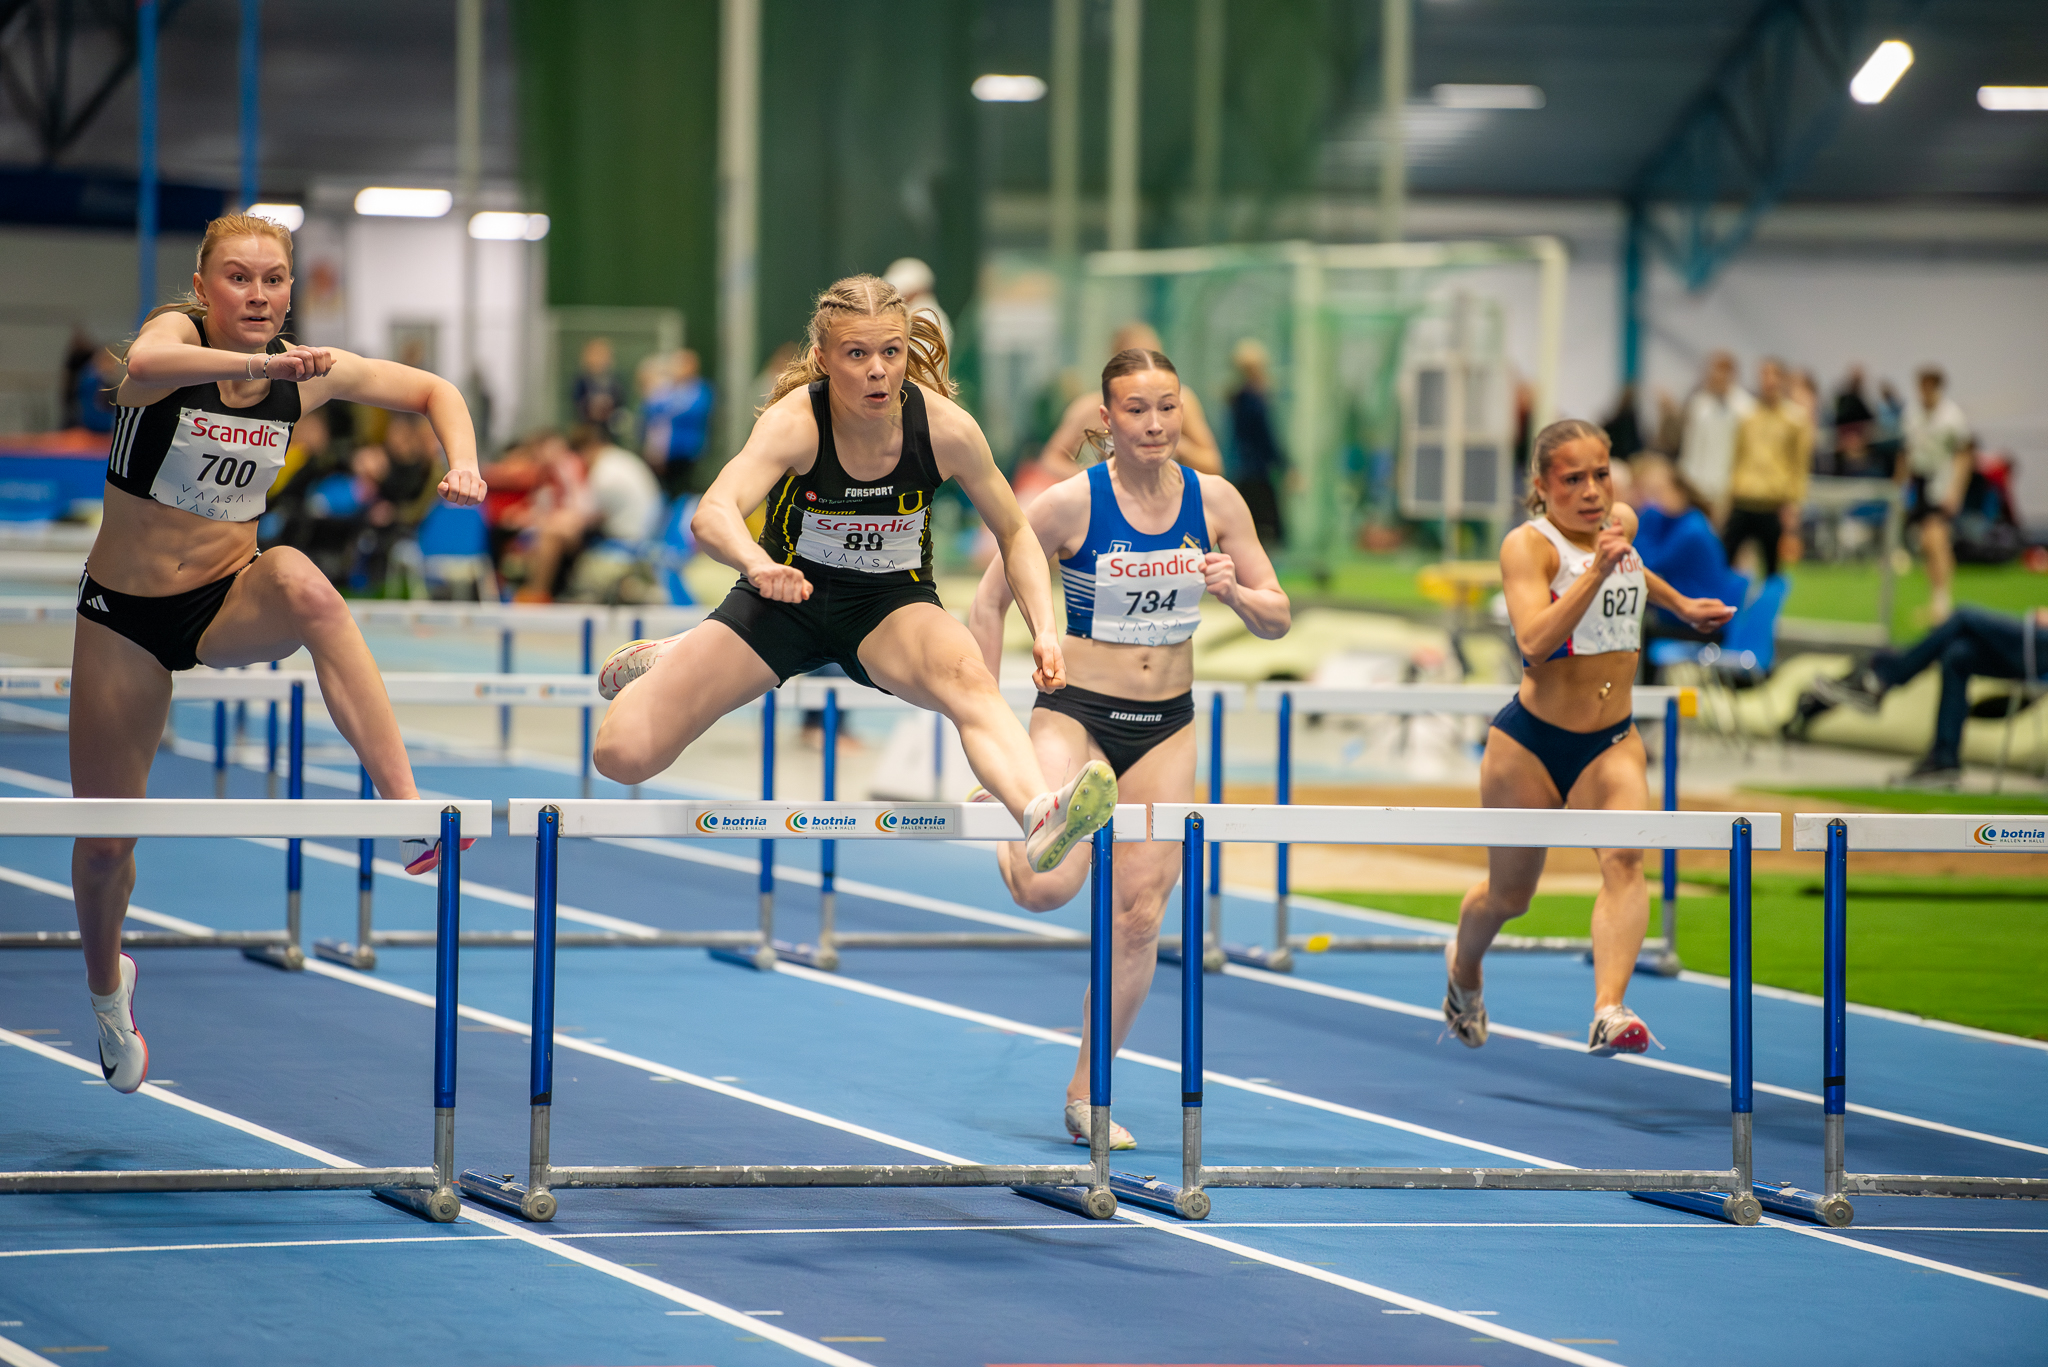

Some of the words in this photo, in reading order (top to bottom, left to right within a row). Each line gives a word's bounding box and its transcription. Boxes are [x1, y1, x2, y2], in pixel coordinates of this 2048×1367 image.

[190, 417, 279, 447] Scandic
[196, 453, 257, 488] 700
[844, 486, 894, 498] FORSPORT
[816, 519, 916, 533] Scandic
[1110, 554, 1197, 578] Scandic
[1126, 589, 1178, 617] 734
[1603, 586, 1639, 618] 627
[1110, 711, 1162, 721] noname
[722, 816, 767, 826] botnia
[811, 816, 856, 826] botnia
[901, 816, 946, 826] botnia
[2001, 829, 2045, 838] botnia
